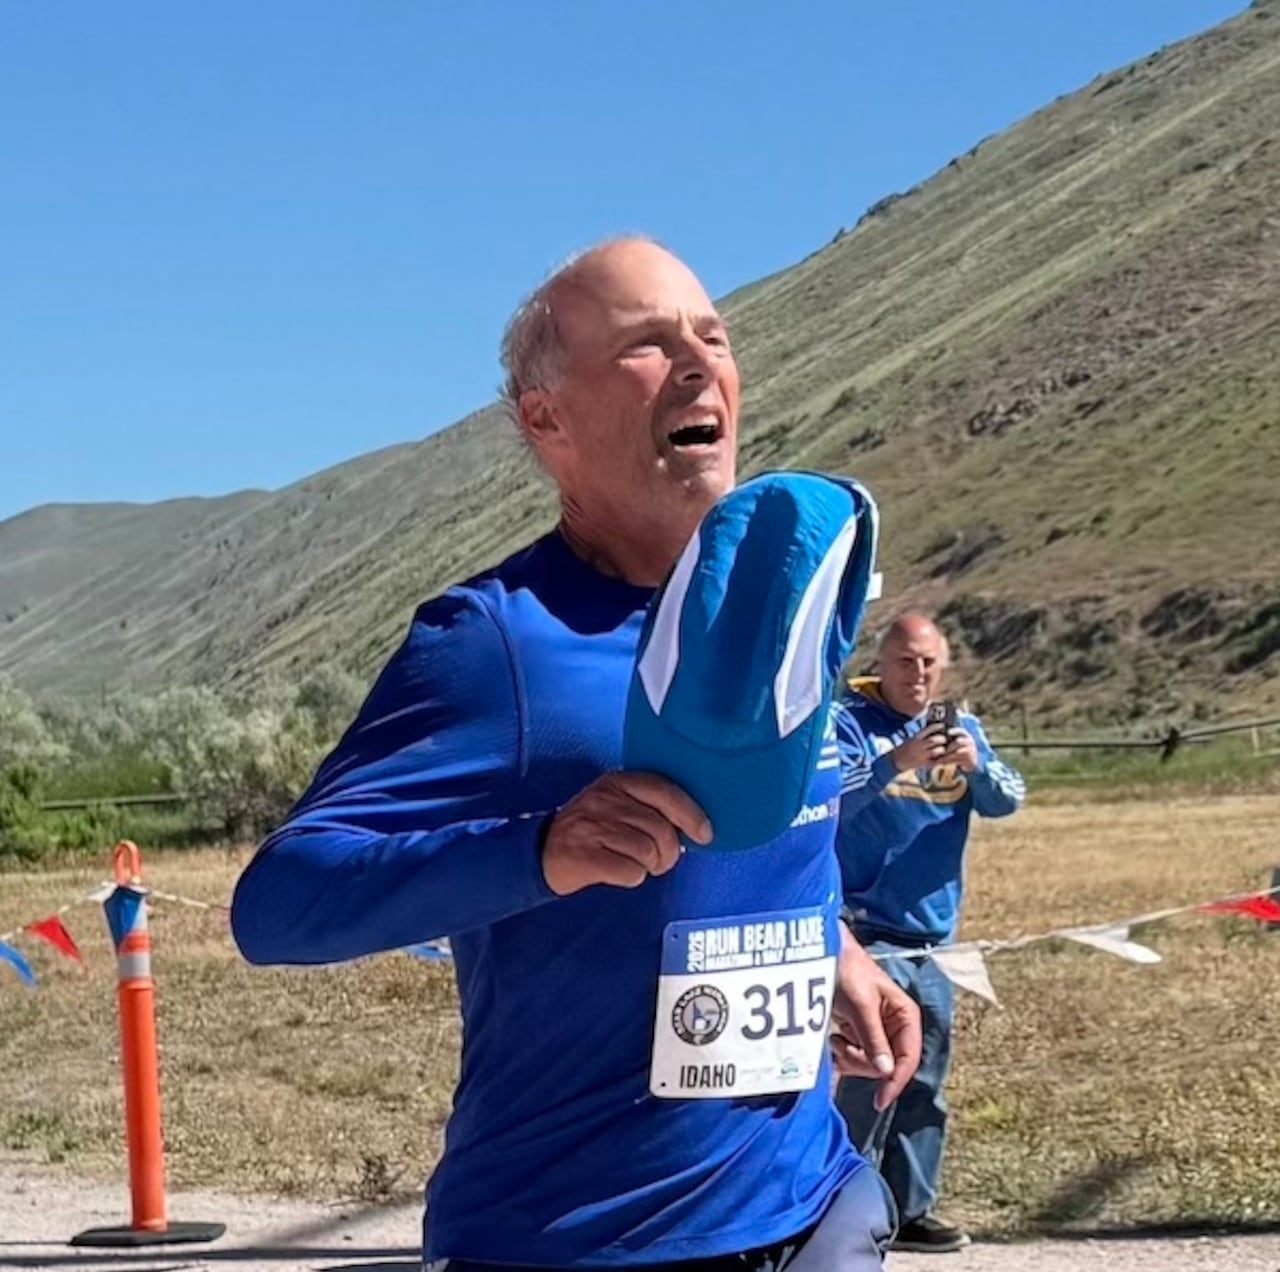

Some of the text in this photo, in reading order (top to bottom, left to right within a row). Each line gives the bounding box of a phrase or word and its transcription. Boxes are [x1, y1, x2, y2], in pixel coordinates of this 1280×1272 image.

[705, 926, 740, 957] RUN
[743, 920, 787, 952] BEAR
[740, 976, 826, 1041] 315
[679, 1063, 737, 1089] IDAHO
